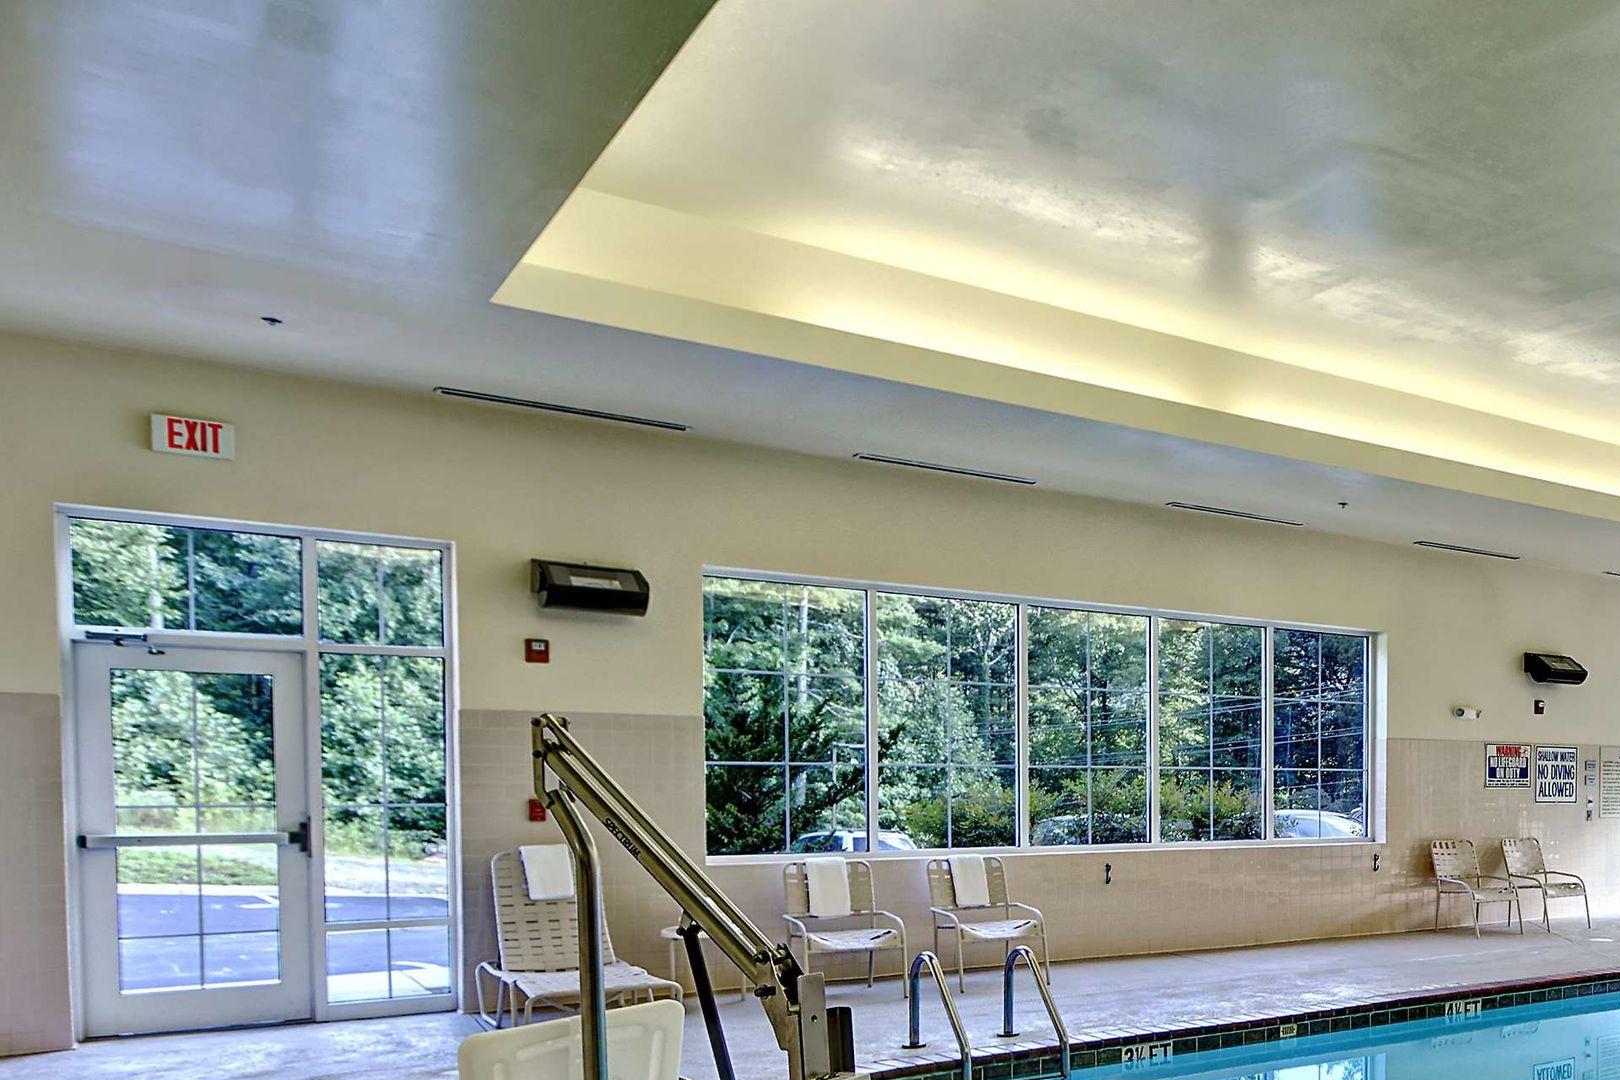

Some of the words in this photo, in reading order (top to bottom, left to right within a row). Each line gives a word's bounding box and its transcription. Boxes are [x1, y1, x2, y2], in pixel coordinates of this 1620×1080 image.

[167, 417, 223, 454] EXIT
[1538, 751, 1558, 762] SHALLOW
[1560, 752, 1575, 762] WATER
[1538, 764, 1549, 780] NO
[1551, 765, 1574, 780] DIVING
[1538, 782, 1574, 798] ALLOWED
[1464, 1000, 1481, 1014] FT
[1149, 1042, 1172, 1060] FT
